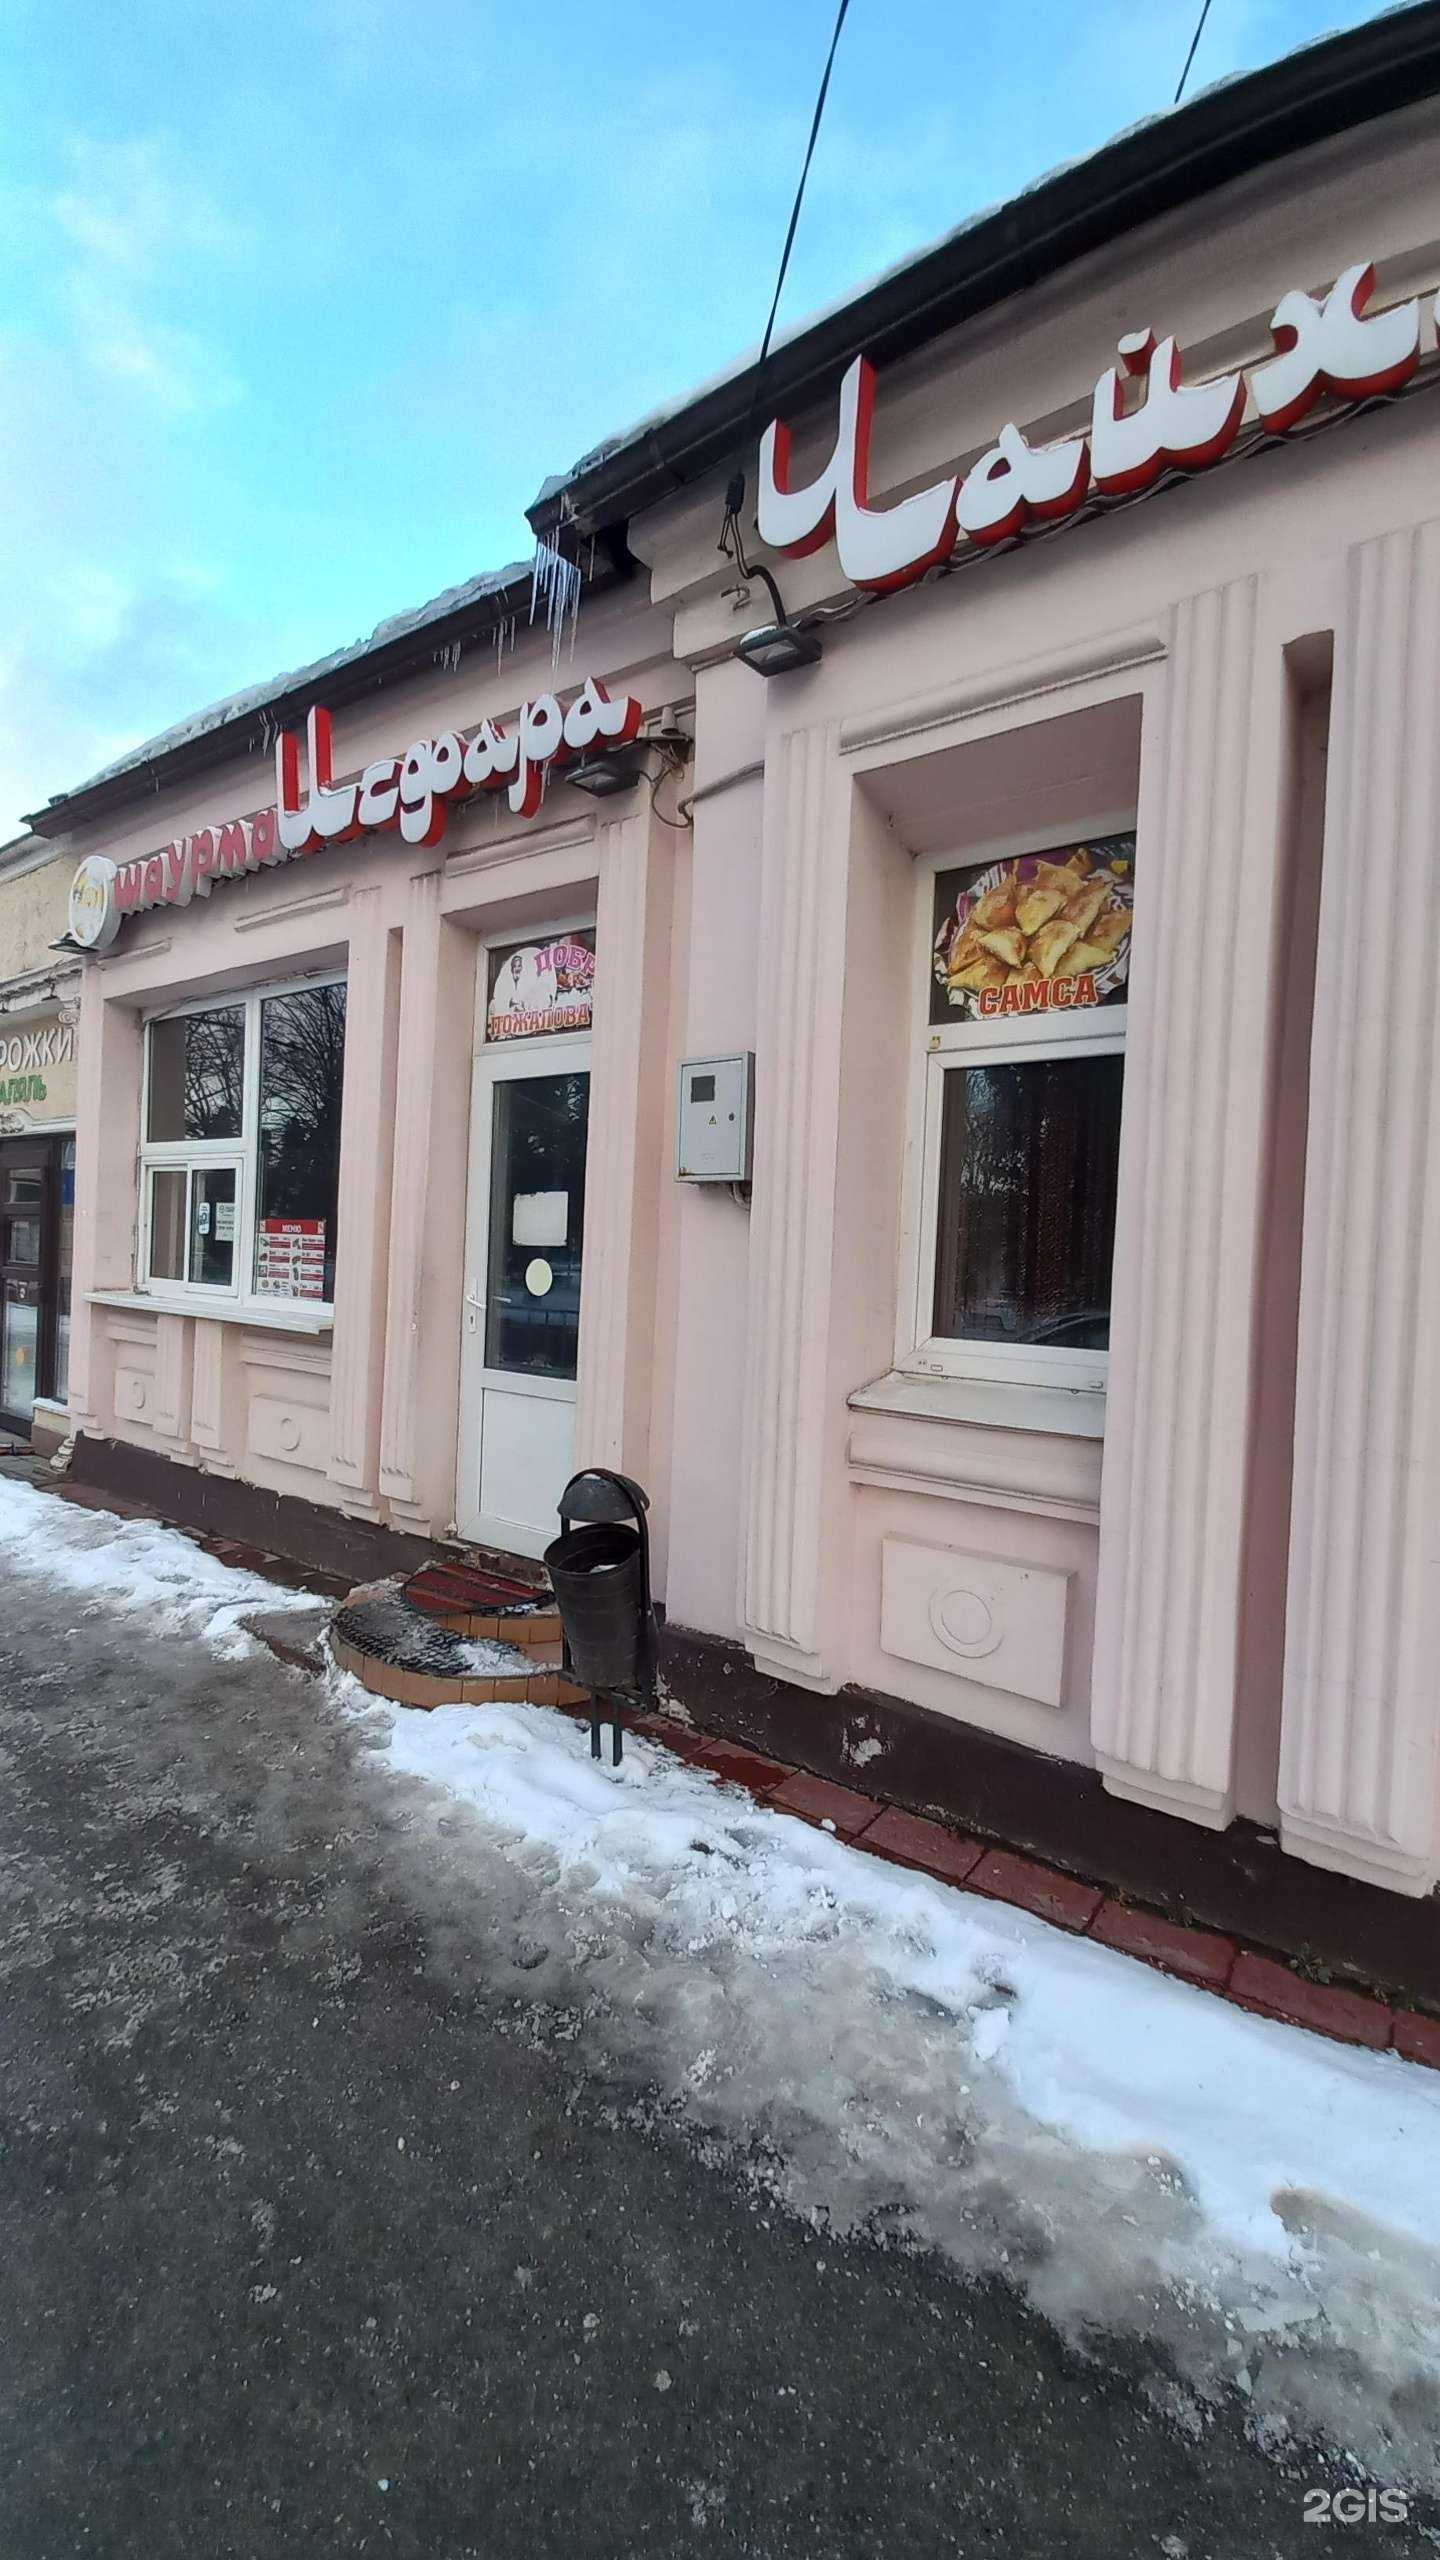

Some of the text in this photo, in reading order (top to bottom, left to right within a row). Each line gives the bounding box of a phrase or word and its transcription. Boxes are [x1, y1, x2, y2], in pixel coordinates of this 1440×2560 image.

[758, 262, 1440, 594] Чайх
[978, 974, 1098, 1016] САМСА
[281, 1224, 302, 1233] МЕНЮ
